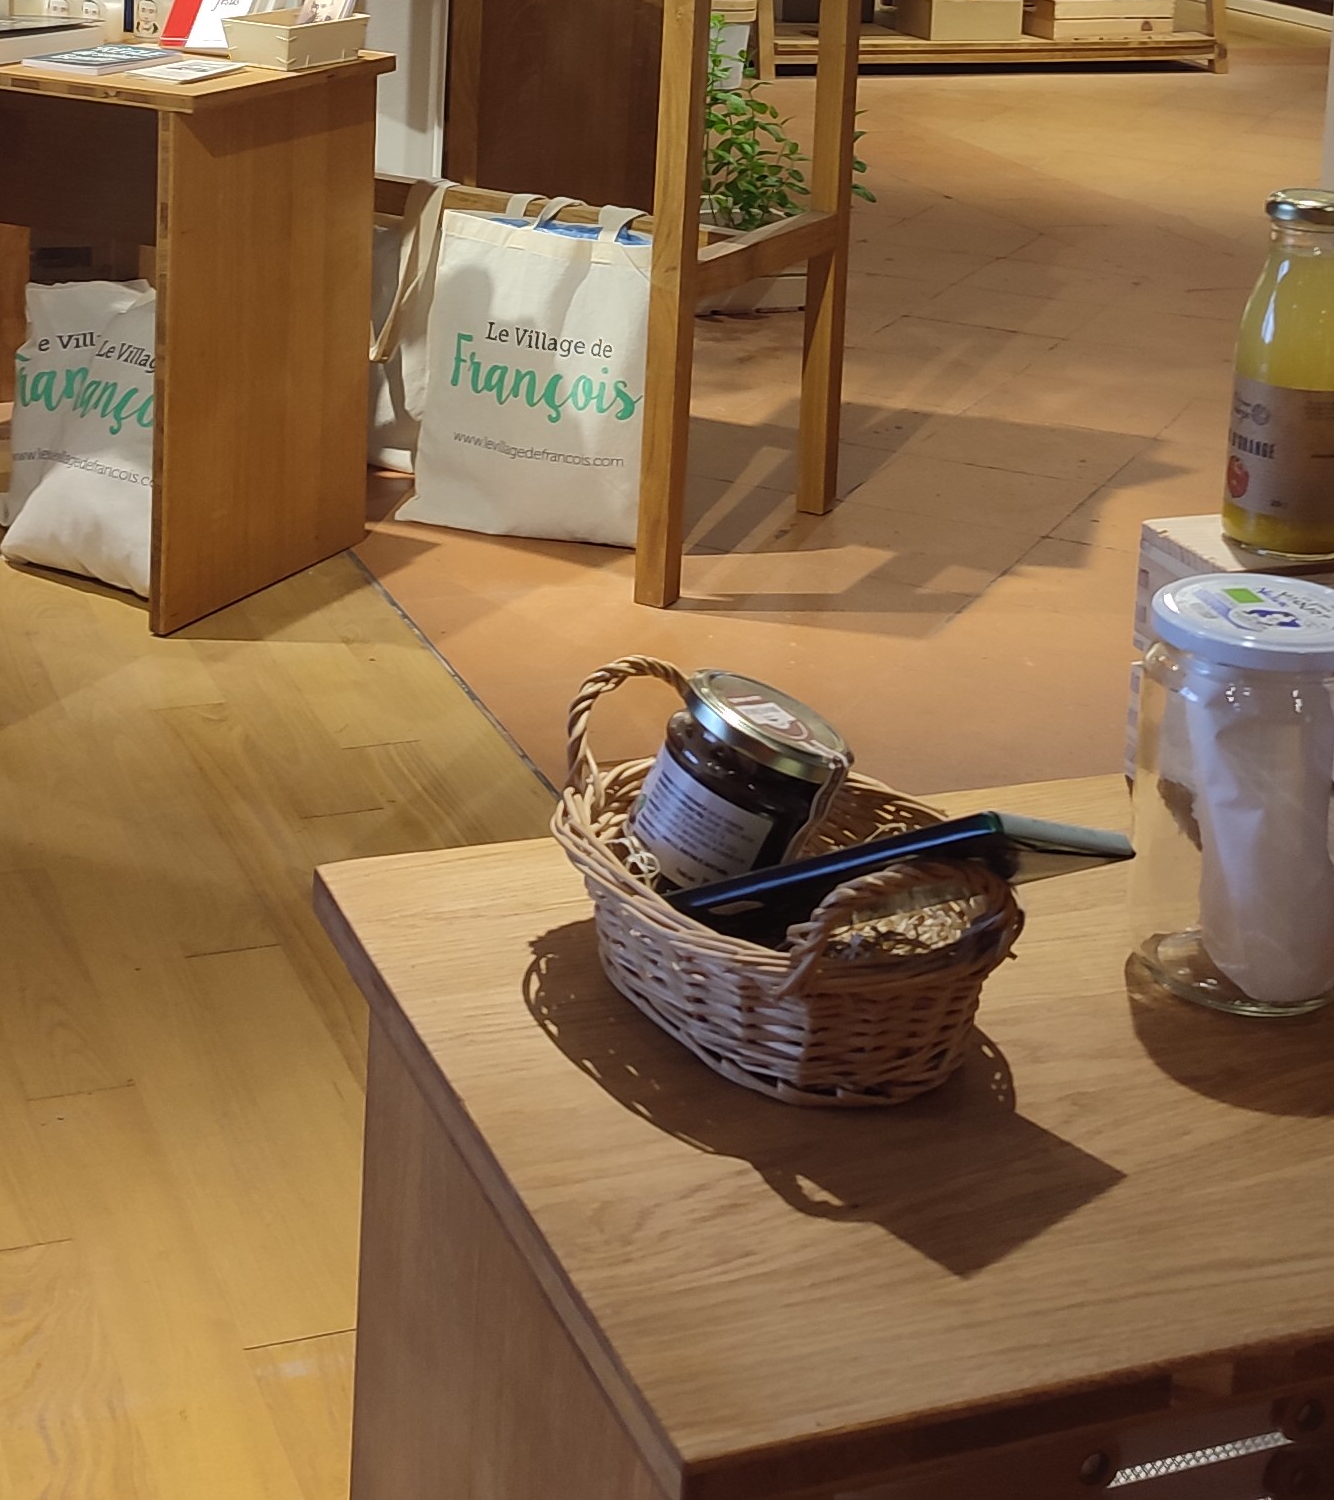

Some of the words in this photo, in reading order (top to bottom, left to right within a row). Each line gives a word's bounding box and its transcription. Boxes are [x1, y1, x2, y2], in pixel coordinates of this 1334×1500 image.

[38, 338, 50, 352] e
[57, 332, 96, 350] Vill
[96, 340, 115, 359] Le
[117, 342, 156, 374] Villag
[484, 321, 509, 343] Le
[515, 327, 586, 358] Village
[590, 339, 613, 359] de
[451, 332, 644, 424] François
[453, 430, 625, 468] www.levillagedefrancois.com
